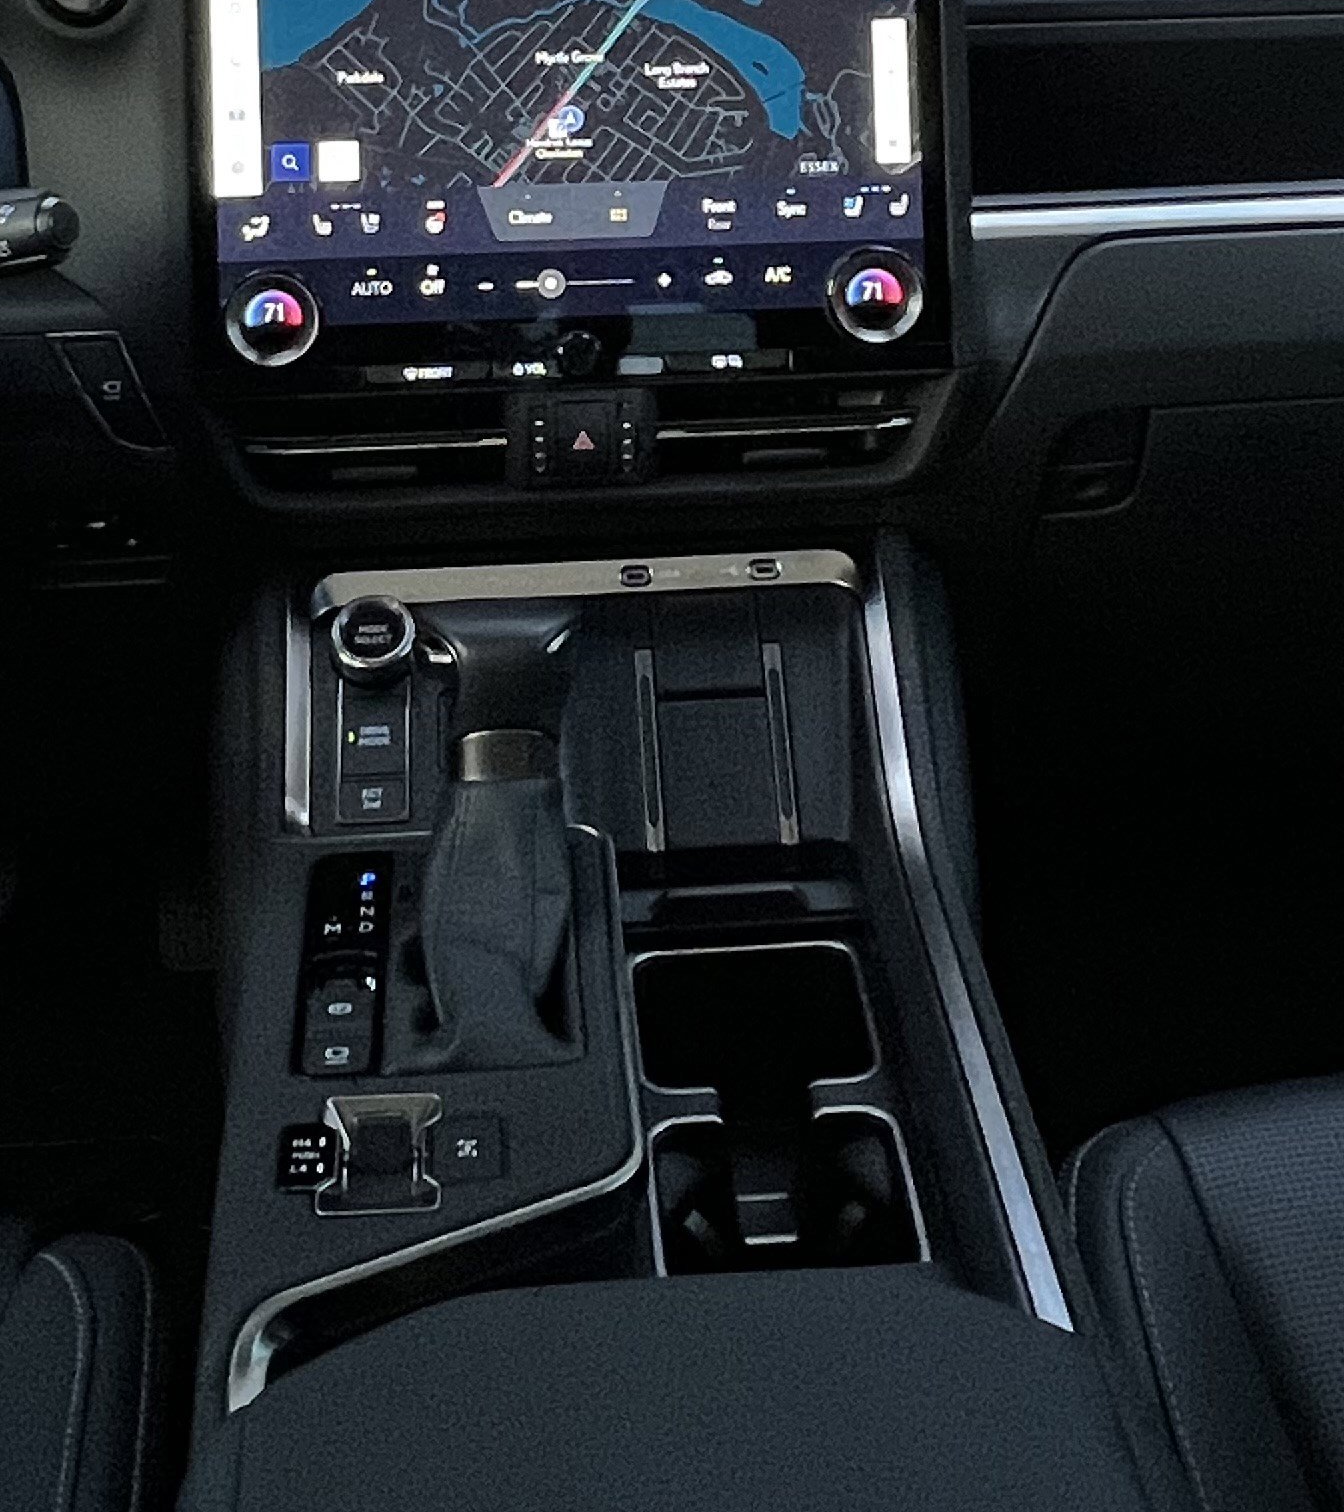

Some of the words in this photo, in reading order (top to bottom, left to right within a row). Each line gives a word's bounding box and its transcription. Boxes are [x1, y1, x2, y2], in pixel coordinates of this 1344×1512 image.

[701, 198, 736, 214] Front
[776, 200, 808, 219] Sync
[764, 265, 792, 283] A/C
[351, 280, 393, 296] AUTO
[862, 281, 884, 302] 71
[264, 302, 285, 324] 71
[359, 906, 375, 918] N
[323, 922, 342, 936] M
[358, 920, 375, 934] D
